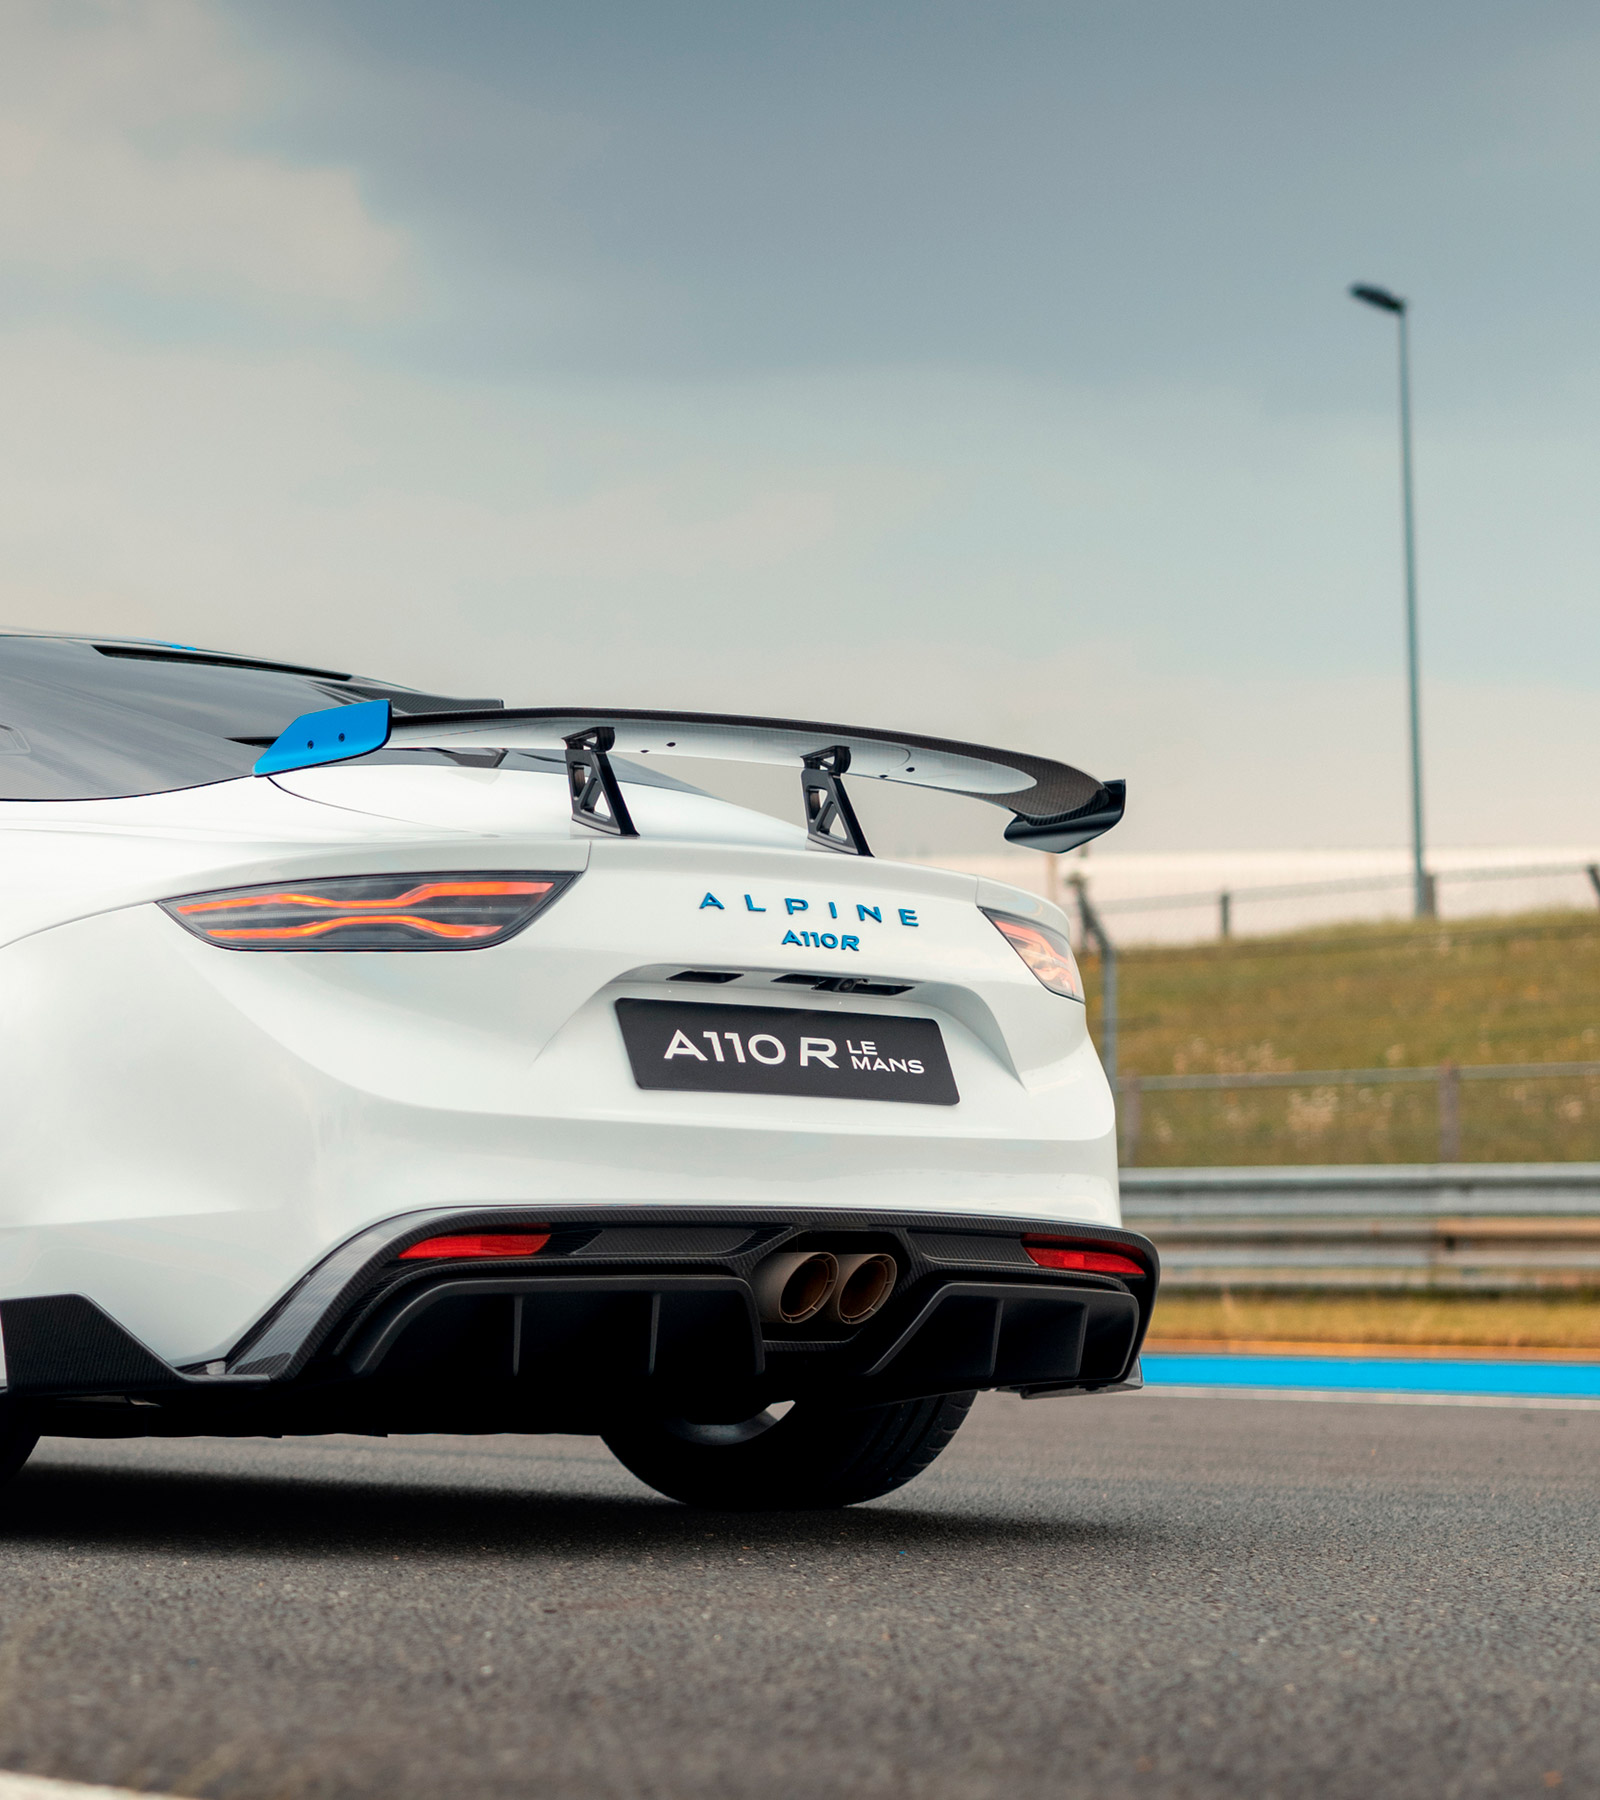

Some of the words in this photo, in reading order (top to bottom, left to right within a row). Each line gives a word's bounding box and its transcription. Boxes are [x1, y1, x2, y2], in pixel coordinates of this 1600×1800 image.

[699, 892, 919, 927] ALPINE
[663, 1029, 786, 1065] A110
[800, 1036, 839, 1069] R
[846, 1039, 878, 1056] LE
[850, 1055, 925, 1074] MANS
